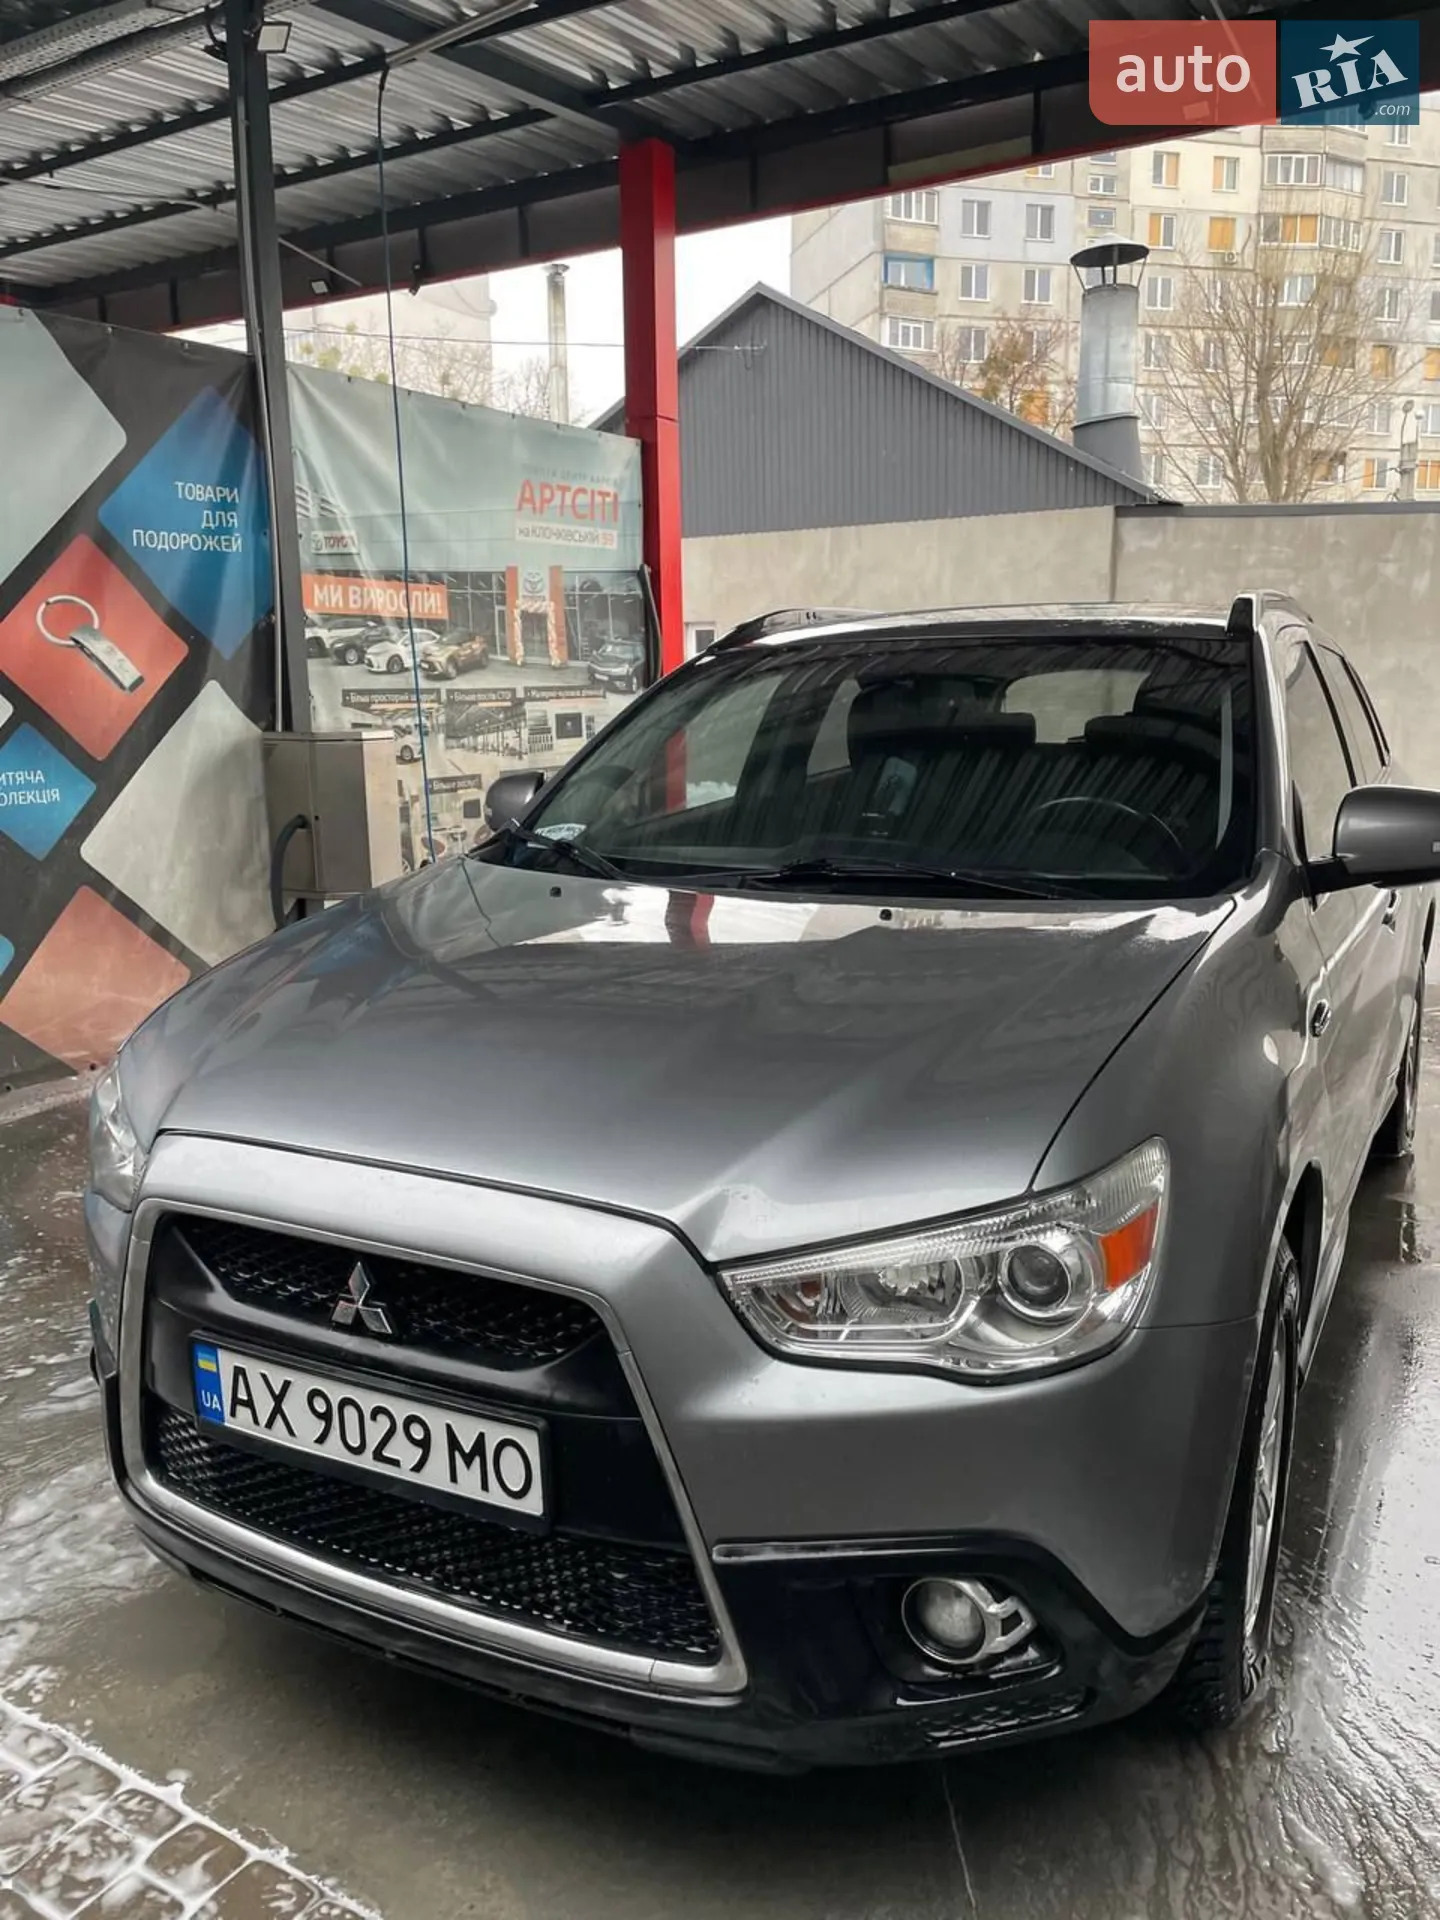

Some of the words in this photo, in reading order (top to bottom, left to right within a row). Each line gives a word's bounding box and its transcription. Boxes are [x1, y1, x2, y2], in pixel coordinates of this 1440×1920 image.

[174, 481, 239, 504] ТОВАРИ
[517, 478, 619, 524] АРТСІТІ
[201, 509, 238, 530] ДЛЯ
[132, 529, 243, 553] ПОДОРОЖЕЙ
[313, 583, 344, 608] МИ
[201, 1389, 222, 1412] UA
[230, 1364, 296, 1438] AX
[306, 1387, 432, 1474] 9029
[446, 1422, 533, 1500] MO
